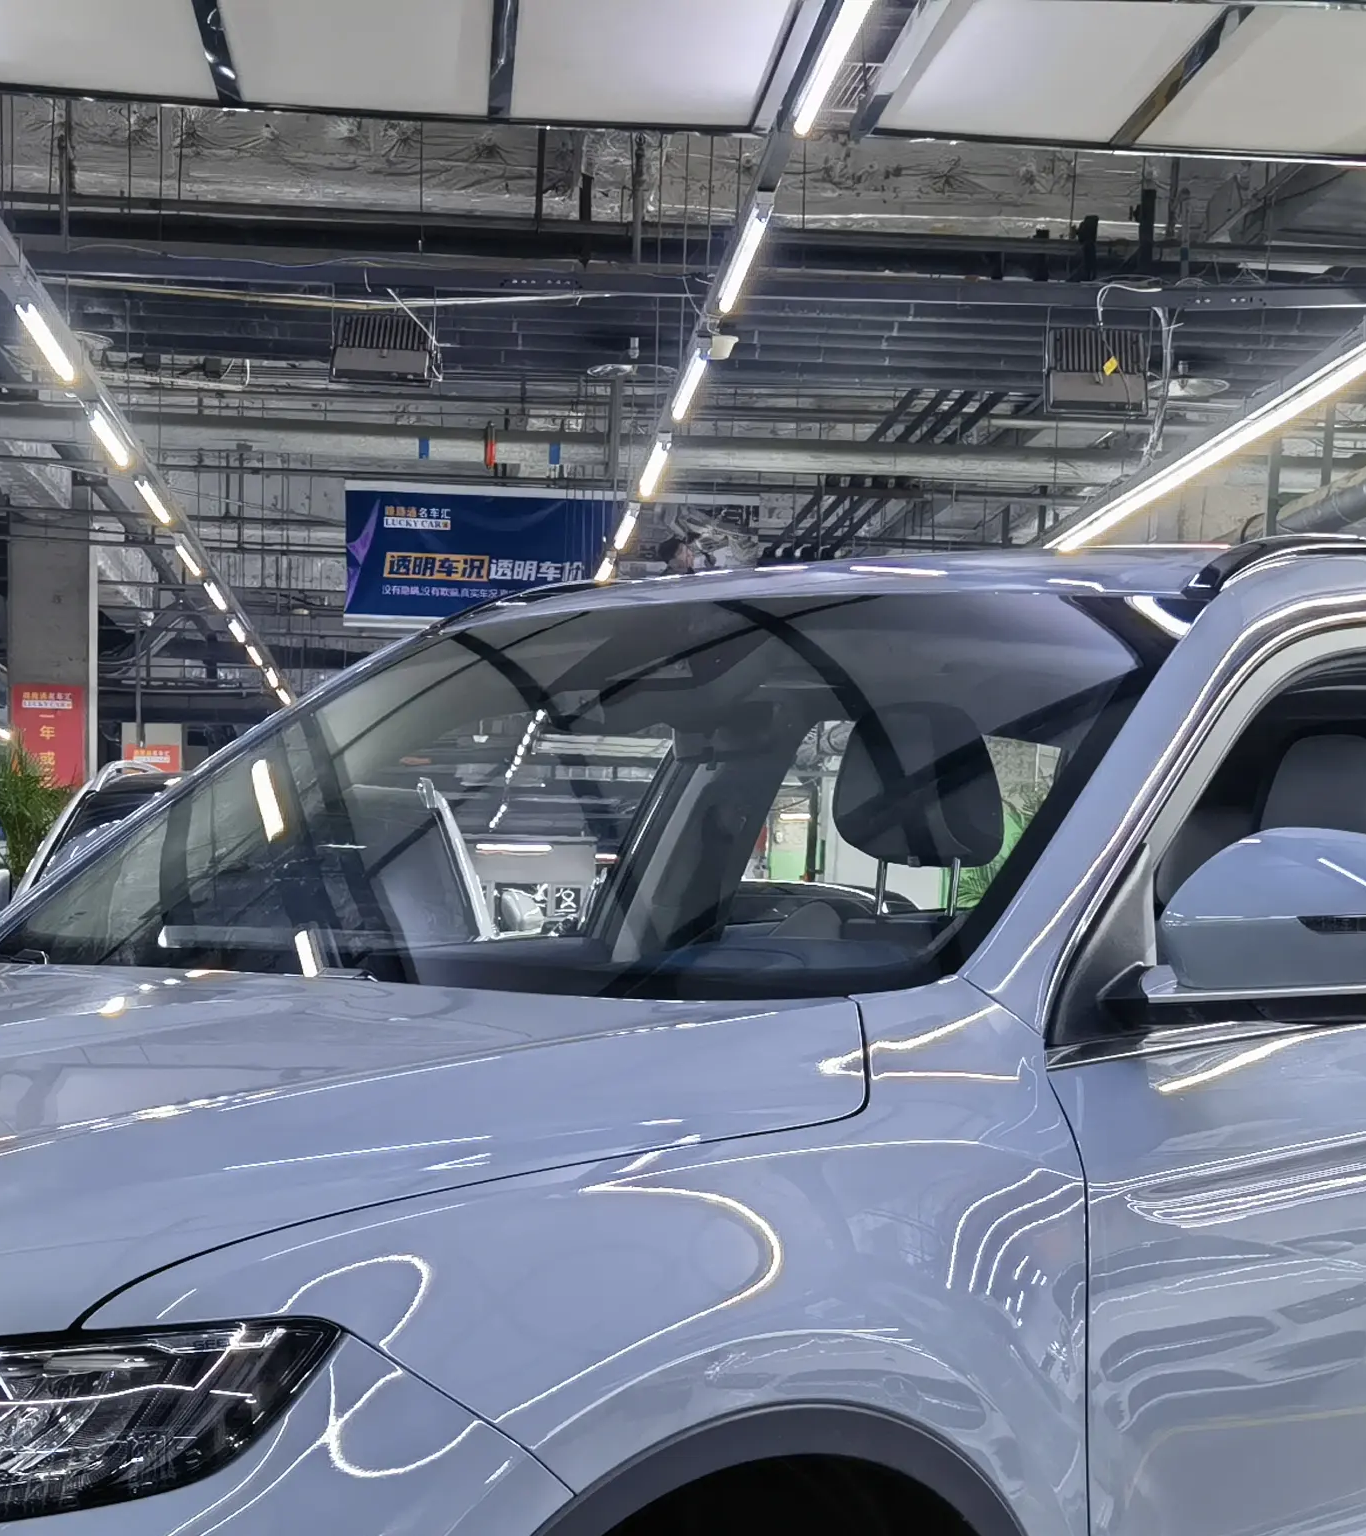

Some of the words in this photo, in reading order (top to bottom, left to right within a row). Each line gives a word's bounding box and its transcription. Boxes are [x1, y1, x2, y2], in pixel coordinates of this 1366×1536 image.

[385, 518, 419, 527] LUCKY
[387, 554, 485, 579] 透明车况
